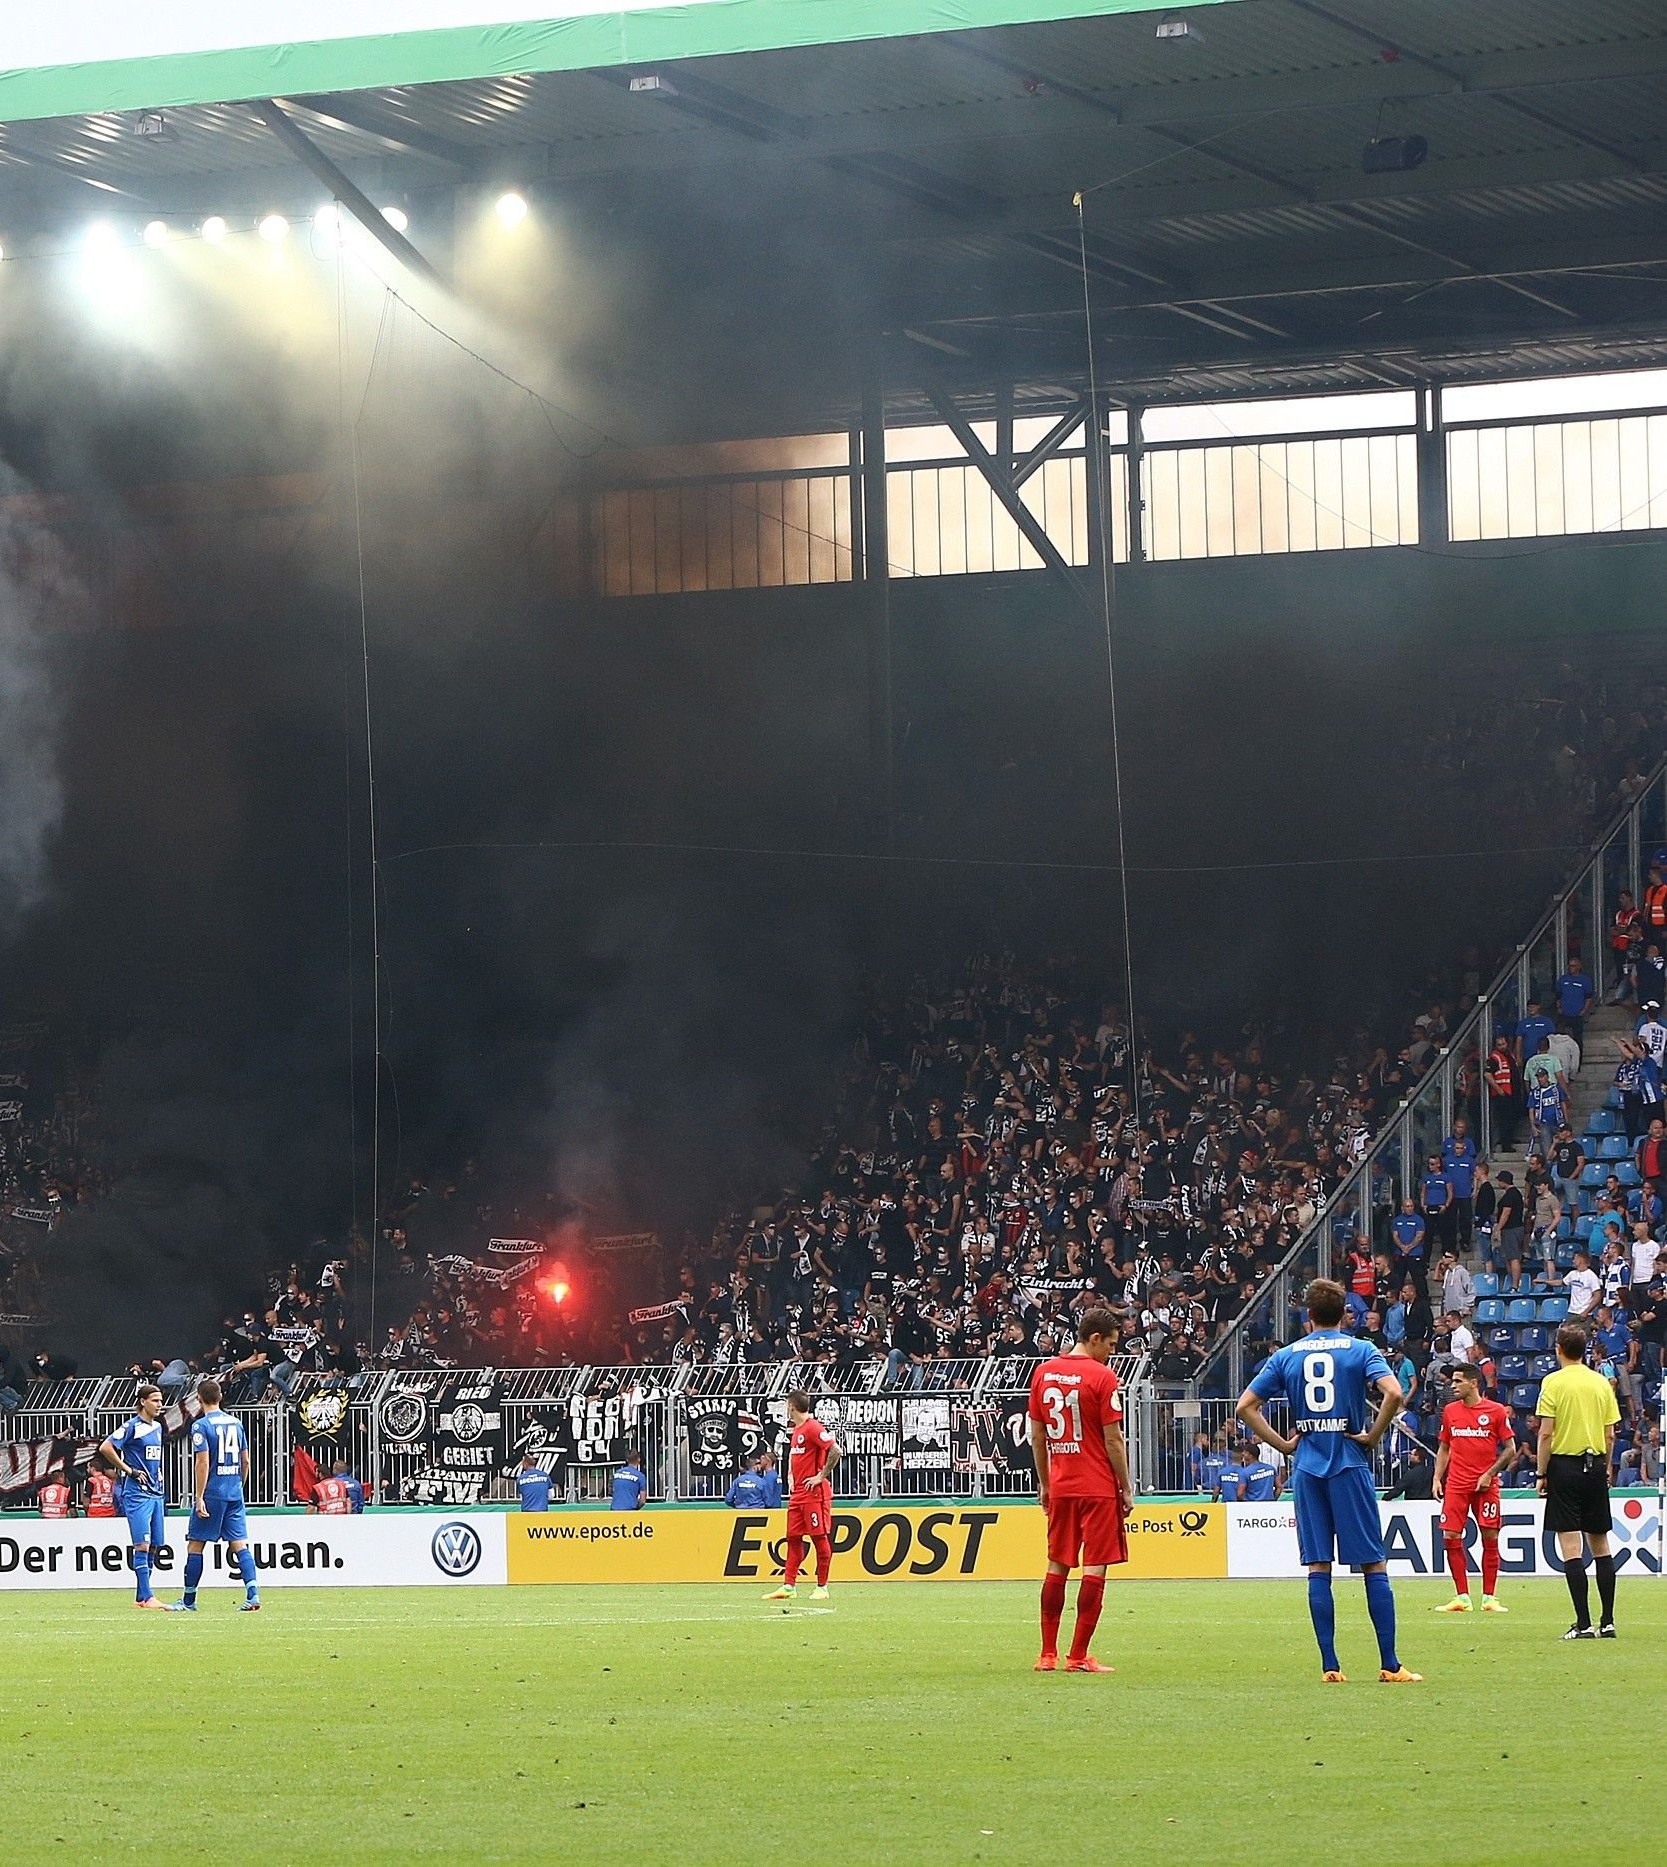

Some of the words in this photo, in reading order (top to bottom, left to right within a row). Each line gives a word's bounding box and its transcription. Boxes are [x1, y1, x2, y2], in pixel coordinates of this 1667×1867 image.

[1020, 1275, 1085, 1290] Eintracht
[1303, 1352, 1335, 1413] 8
[687, 1398, 737, 1419] SPIRIT
[847, 1399, 898, 1423] REGION
[1042, 1387, 1083, 1441] 31
[215, 1424, 240, 1464] 14
[577, 1439, 611, 1462] 64
[845, 1432, 897, 1455] WETTERAU
[443, 1446, 494, 1466] GEBIET
[810, 1512, 819, 1528] 3
[1481, 1501, 1498, 1519] 39
[526, 1521, 654, 1542] www.epost.de
[1142, 1519, 1174, 1533] Post
[1237, 1517, 1278, 1529] TARGO
